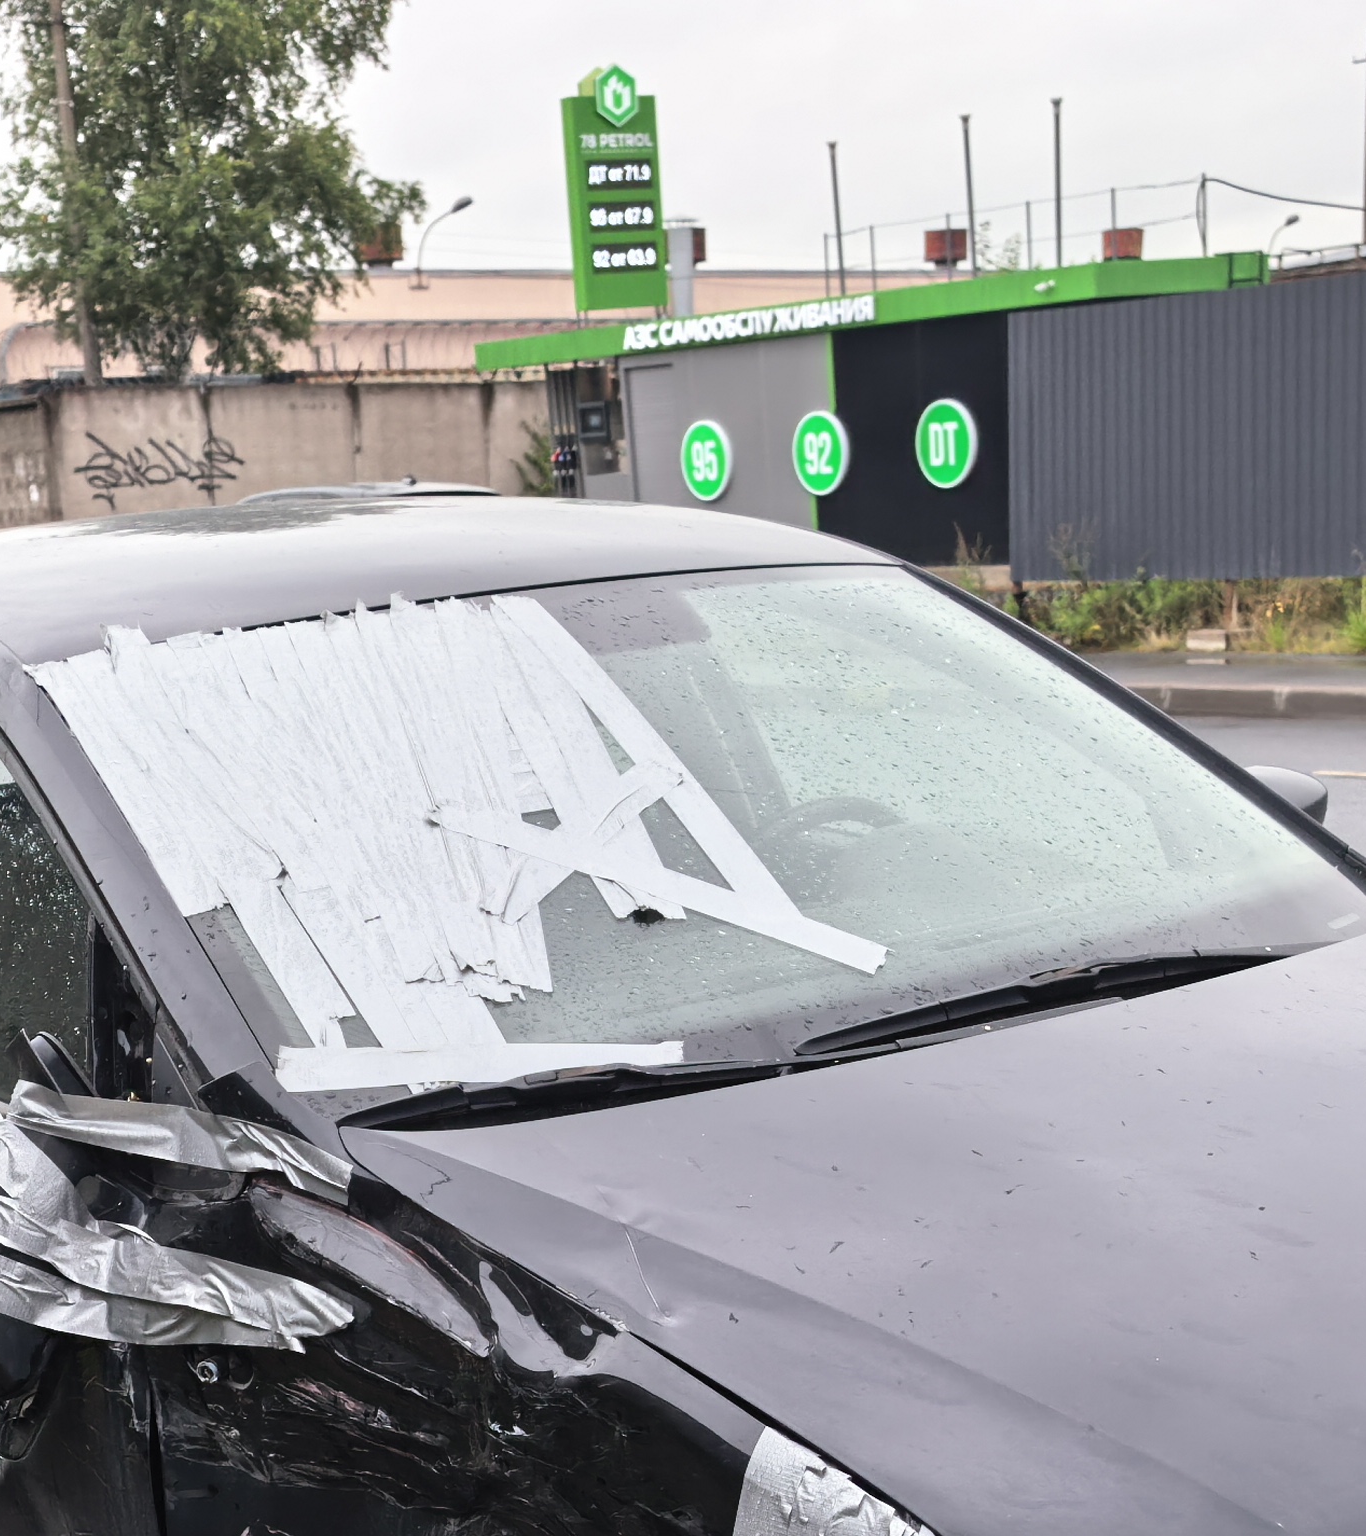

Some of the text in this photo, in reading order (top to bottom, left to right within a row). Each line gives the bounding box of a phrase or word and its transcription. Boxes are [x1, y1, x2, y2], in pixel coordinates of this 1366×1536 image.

[579, 132, 654, 149] 78 PETROL
[588, 163, 652, 185] ДТ от 71.9
[589, 206, 654, 227] 95 от 67.9
[592, 249, 611, 269] 92
[610, 252, 627, 268] от
[623, 294, 876, 351] АЗС САМООБСЛУЖИВАНИЯ
[803, 431, 834, 476] 92
[928, 421, 960, 467] DT
[690, 440, 719, 483] 95
